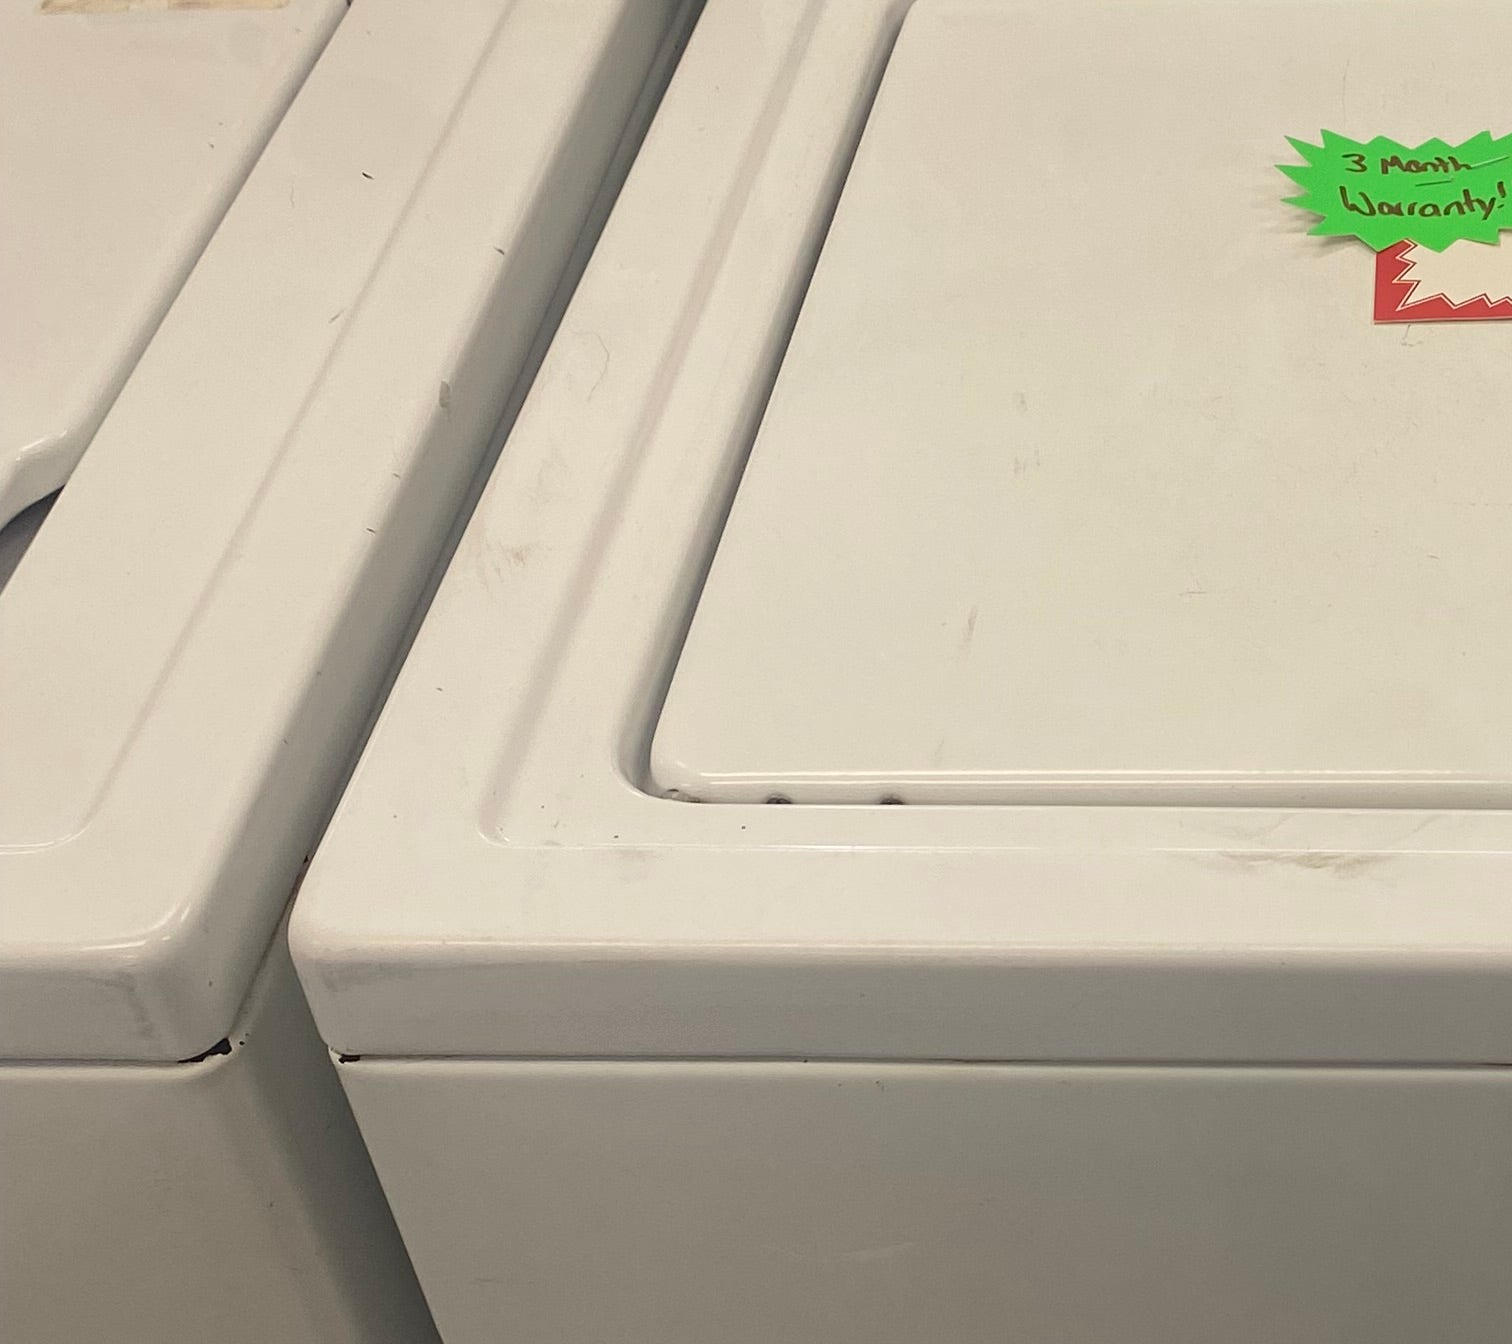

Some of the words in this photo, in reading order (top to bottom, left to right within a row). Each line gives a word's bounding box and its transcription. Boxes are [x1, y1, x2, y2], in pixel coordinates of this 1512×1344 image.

[1344, 153, 1367, 173] 3
[1381, 155, 1473, 175] Month
[1338, 181, 1507, 221] Warranty!
